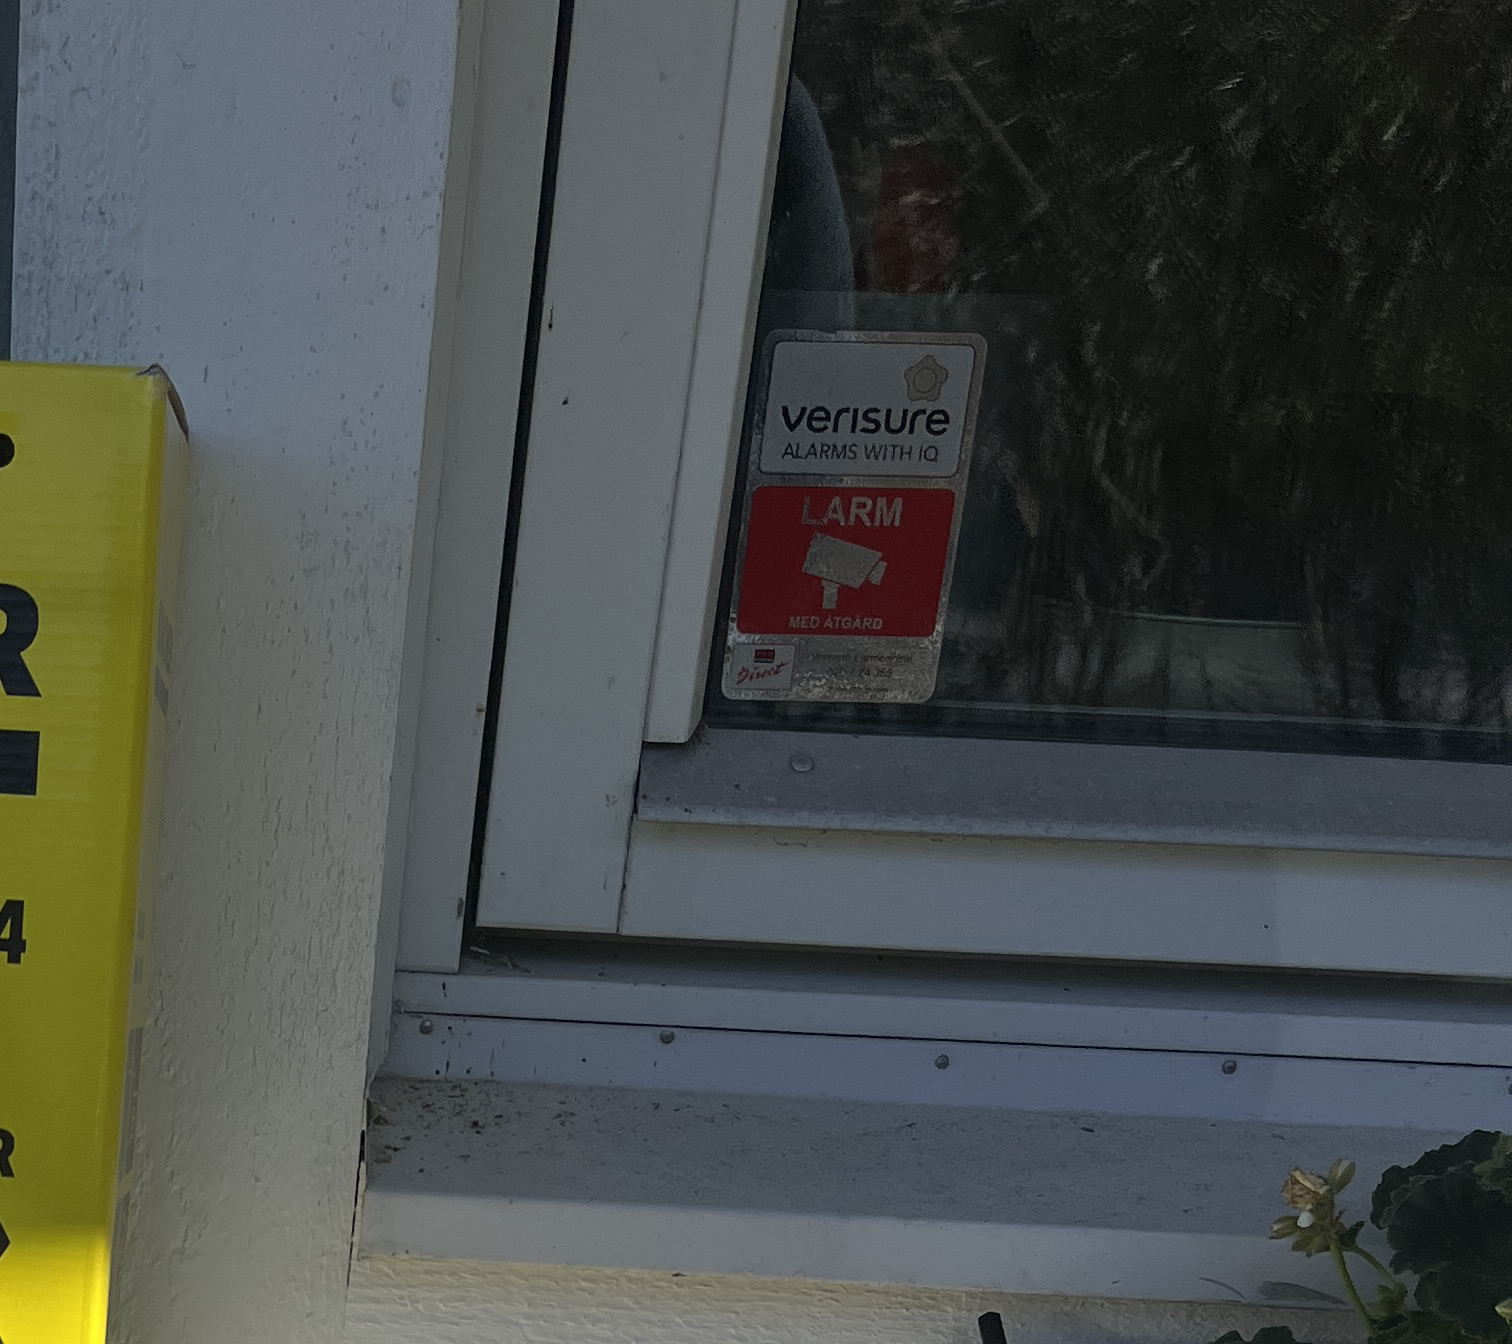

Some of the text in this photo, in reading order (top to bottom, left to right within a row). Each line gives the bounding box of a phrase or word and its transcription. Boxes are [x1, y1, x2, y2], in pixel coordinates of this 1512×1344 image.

[781, 405, 951, 436] verisure
[781, 442, 939, 462] ALARMS WITH IQ
[800, 495, 904, 528] LARM
[788, 615, 820, 629] MED
